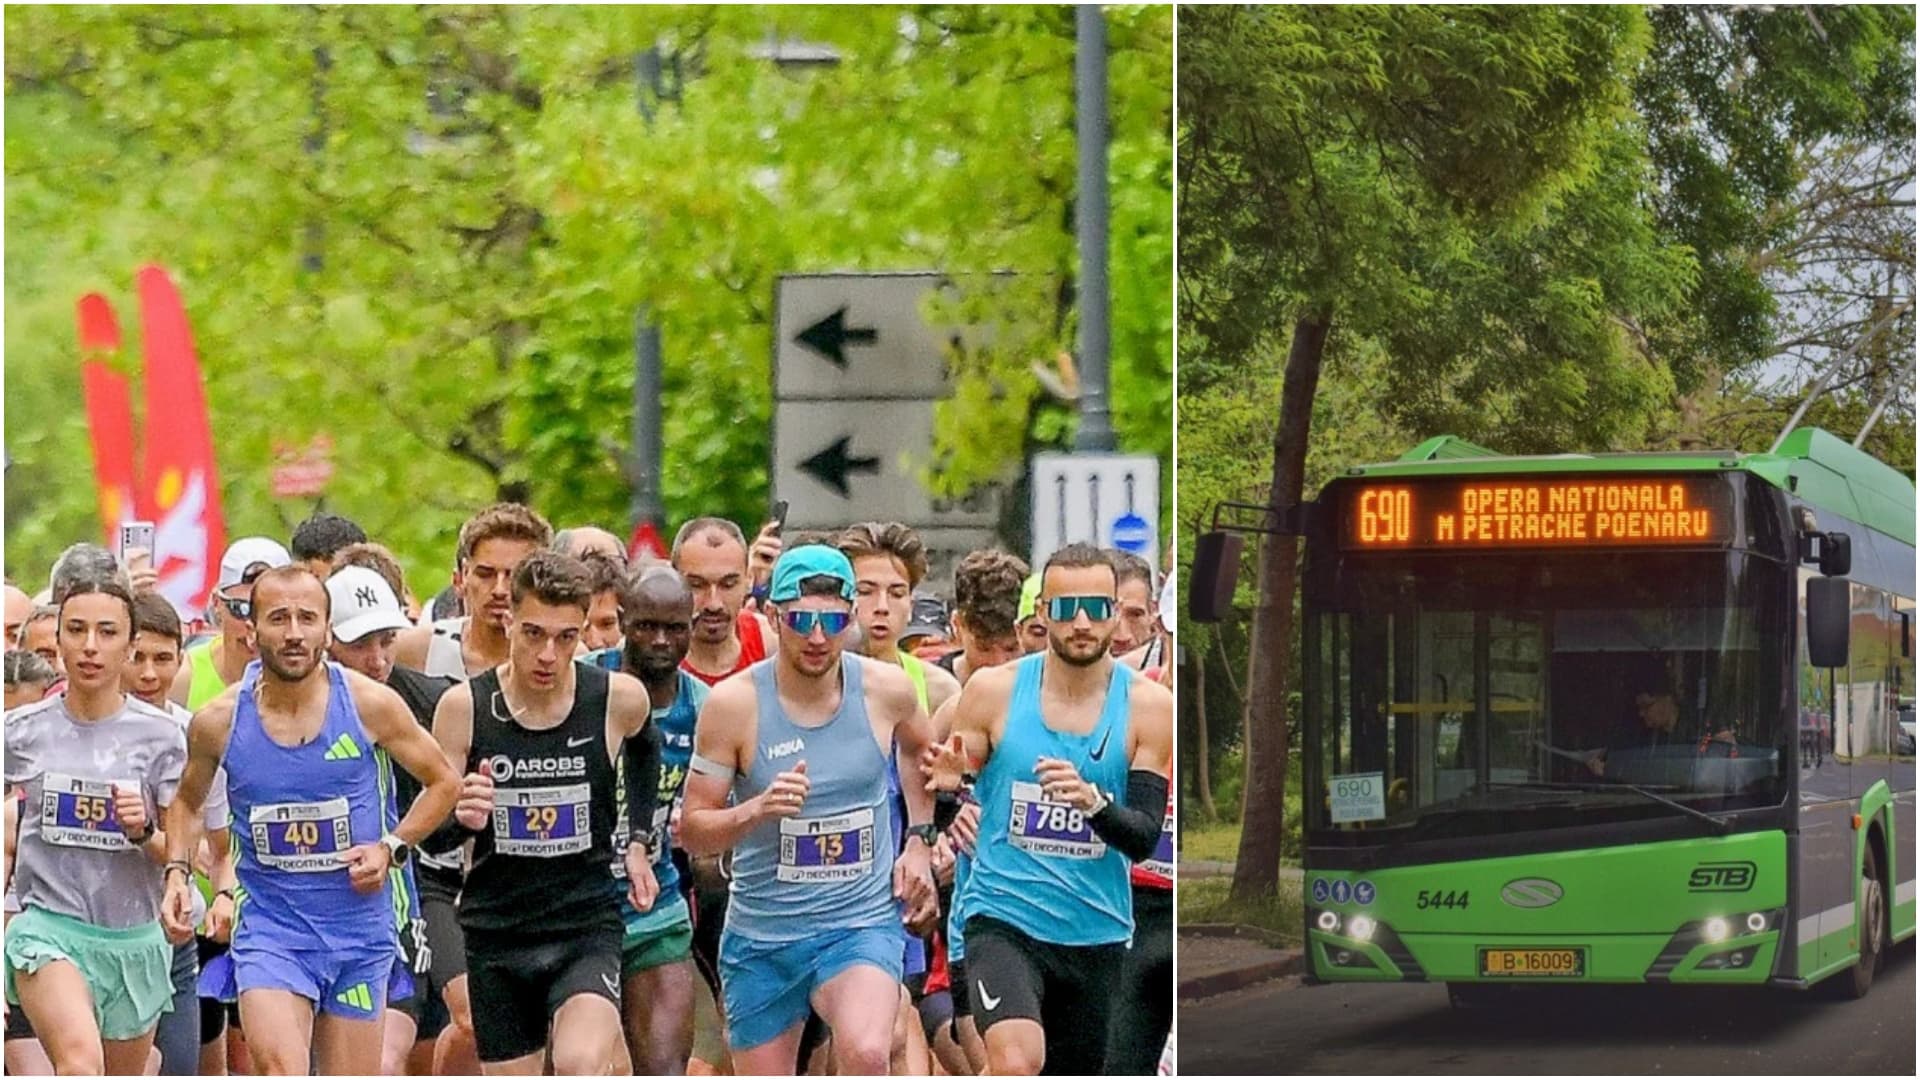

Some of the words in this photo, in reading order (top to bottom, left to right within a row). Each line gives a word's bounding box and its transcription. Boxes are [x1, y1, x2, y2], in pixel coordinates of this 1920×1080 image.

[1463, 487, 1540, 514] OPERA
[1549, 485, 1684, 512] NATIONALA
[1360, 489, 1411, 542] 690
[1438, 515, 1455, 540] M
[1462, 513, 1587, 540] PETRACHE
[1596, 510, 1709, 537] POENARU
[514, 756, 587, 772] AROBS
[1337, 780, 1372, 798] 690
[74, 795, 107, 822] 55
[525, 807, 558, 832] 29
[1035, 804, 1085, 834] 788
[284, 821, 319, 846] 40
[522, 841, 580, 854] DECATHLON
[814, 834, 844, 859] 13
[1033, 841, 1093, 857] DECATHLON
[1687, 867, 1750, 888] STB
[1416, 890, 1470, 910] 5444
[1503, 953, 1516, 970] B
[1524, 953, 1573, 970] 16009
